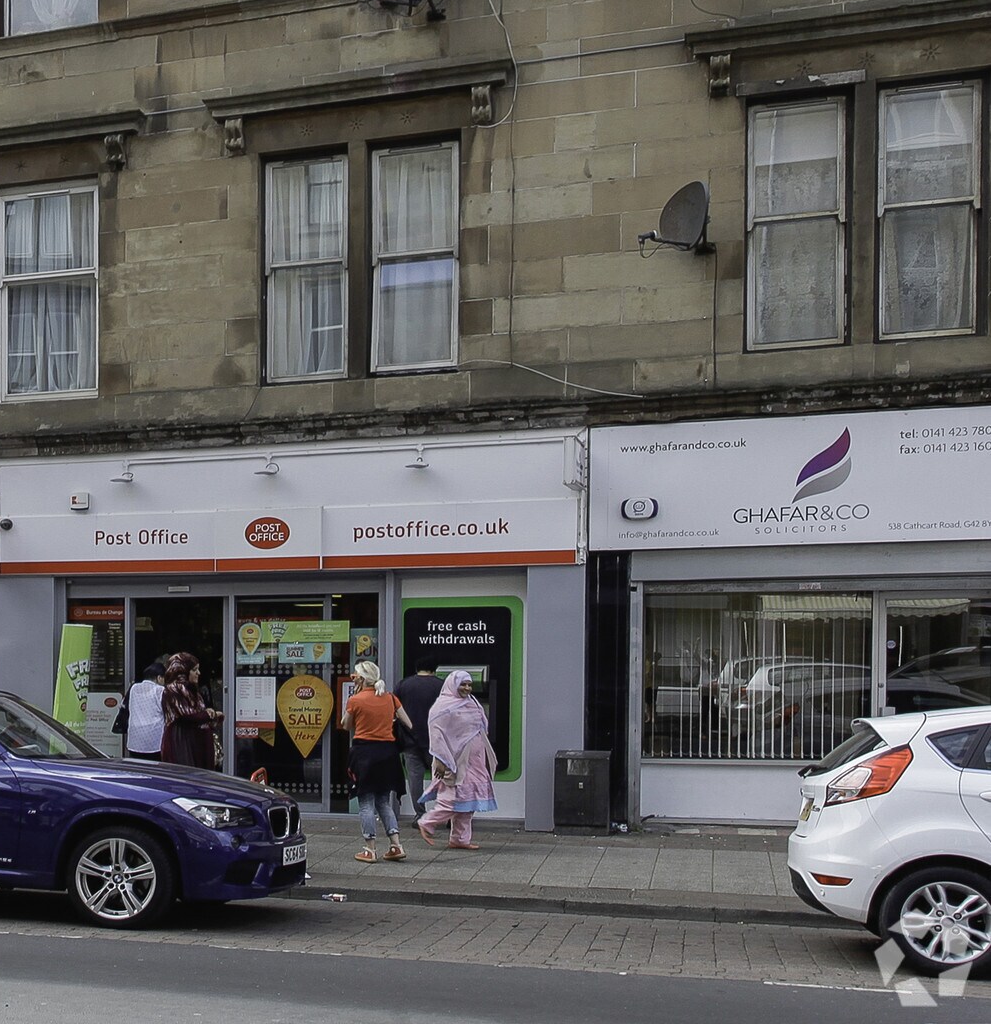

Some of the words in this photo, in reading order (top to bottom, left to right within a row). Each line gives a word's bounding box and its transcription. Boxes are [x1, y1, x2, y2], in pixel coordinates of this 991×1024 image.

[900, 429, 919, 439] tel:
[921, 428, 945, 438] 0141
[949, 427, 968, 436] 423
[620, 438, 747, 454] www.ghafarandco.co.uk
[900, 444, 920, 454] fax:
[923, 443, 946, 453] 0141
[950, 442, 969, 452] 423
[733, 504, 870, 523] GHAFAR&CO
[255, 523, 281, 533] POST
[353, 518, 509, 542] postoffice.co.uk
[755, 524, 846, 535] SOLICITORS
[903, 521, 937, 530] Cathcart
[964, 519, 980, 528] G42
[95, 530, 132, 545] Post
[138, 529, 188, 544] Office
[249, 532, 285, 542] OFFICE
[618, 528, 719, 540] info@ghafarandco.co.uk
[427, 621, 452, 631] free
[457, 620, 487, 631] cash
[419, 633, 495, 644] withdrawals
[288, 713, 322, 726] SALE
[294, 730, 316, 741] Here
